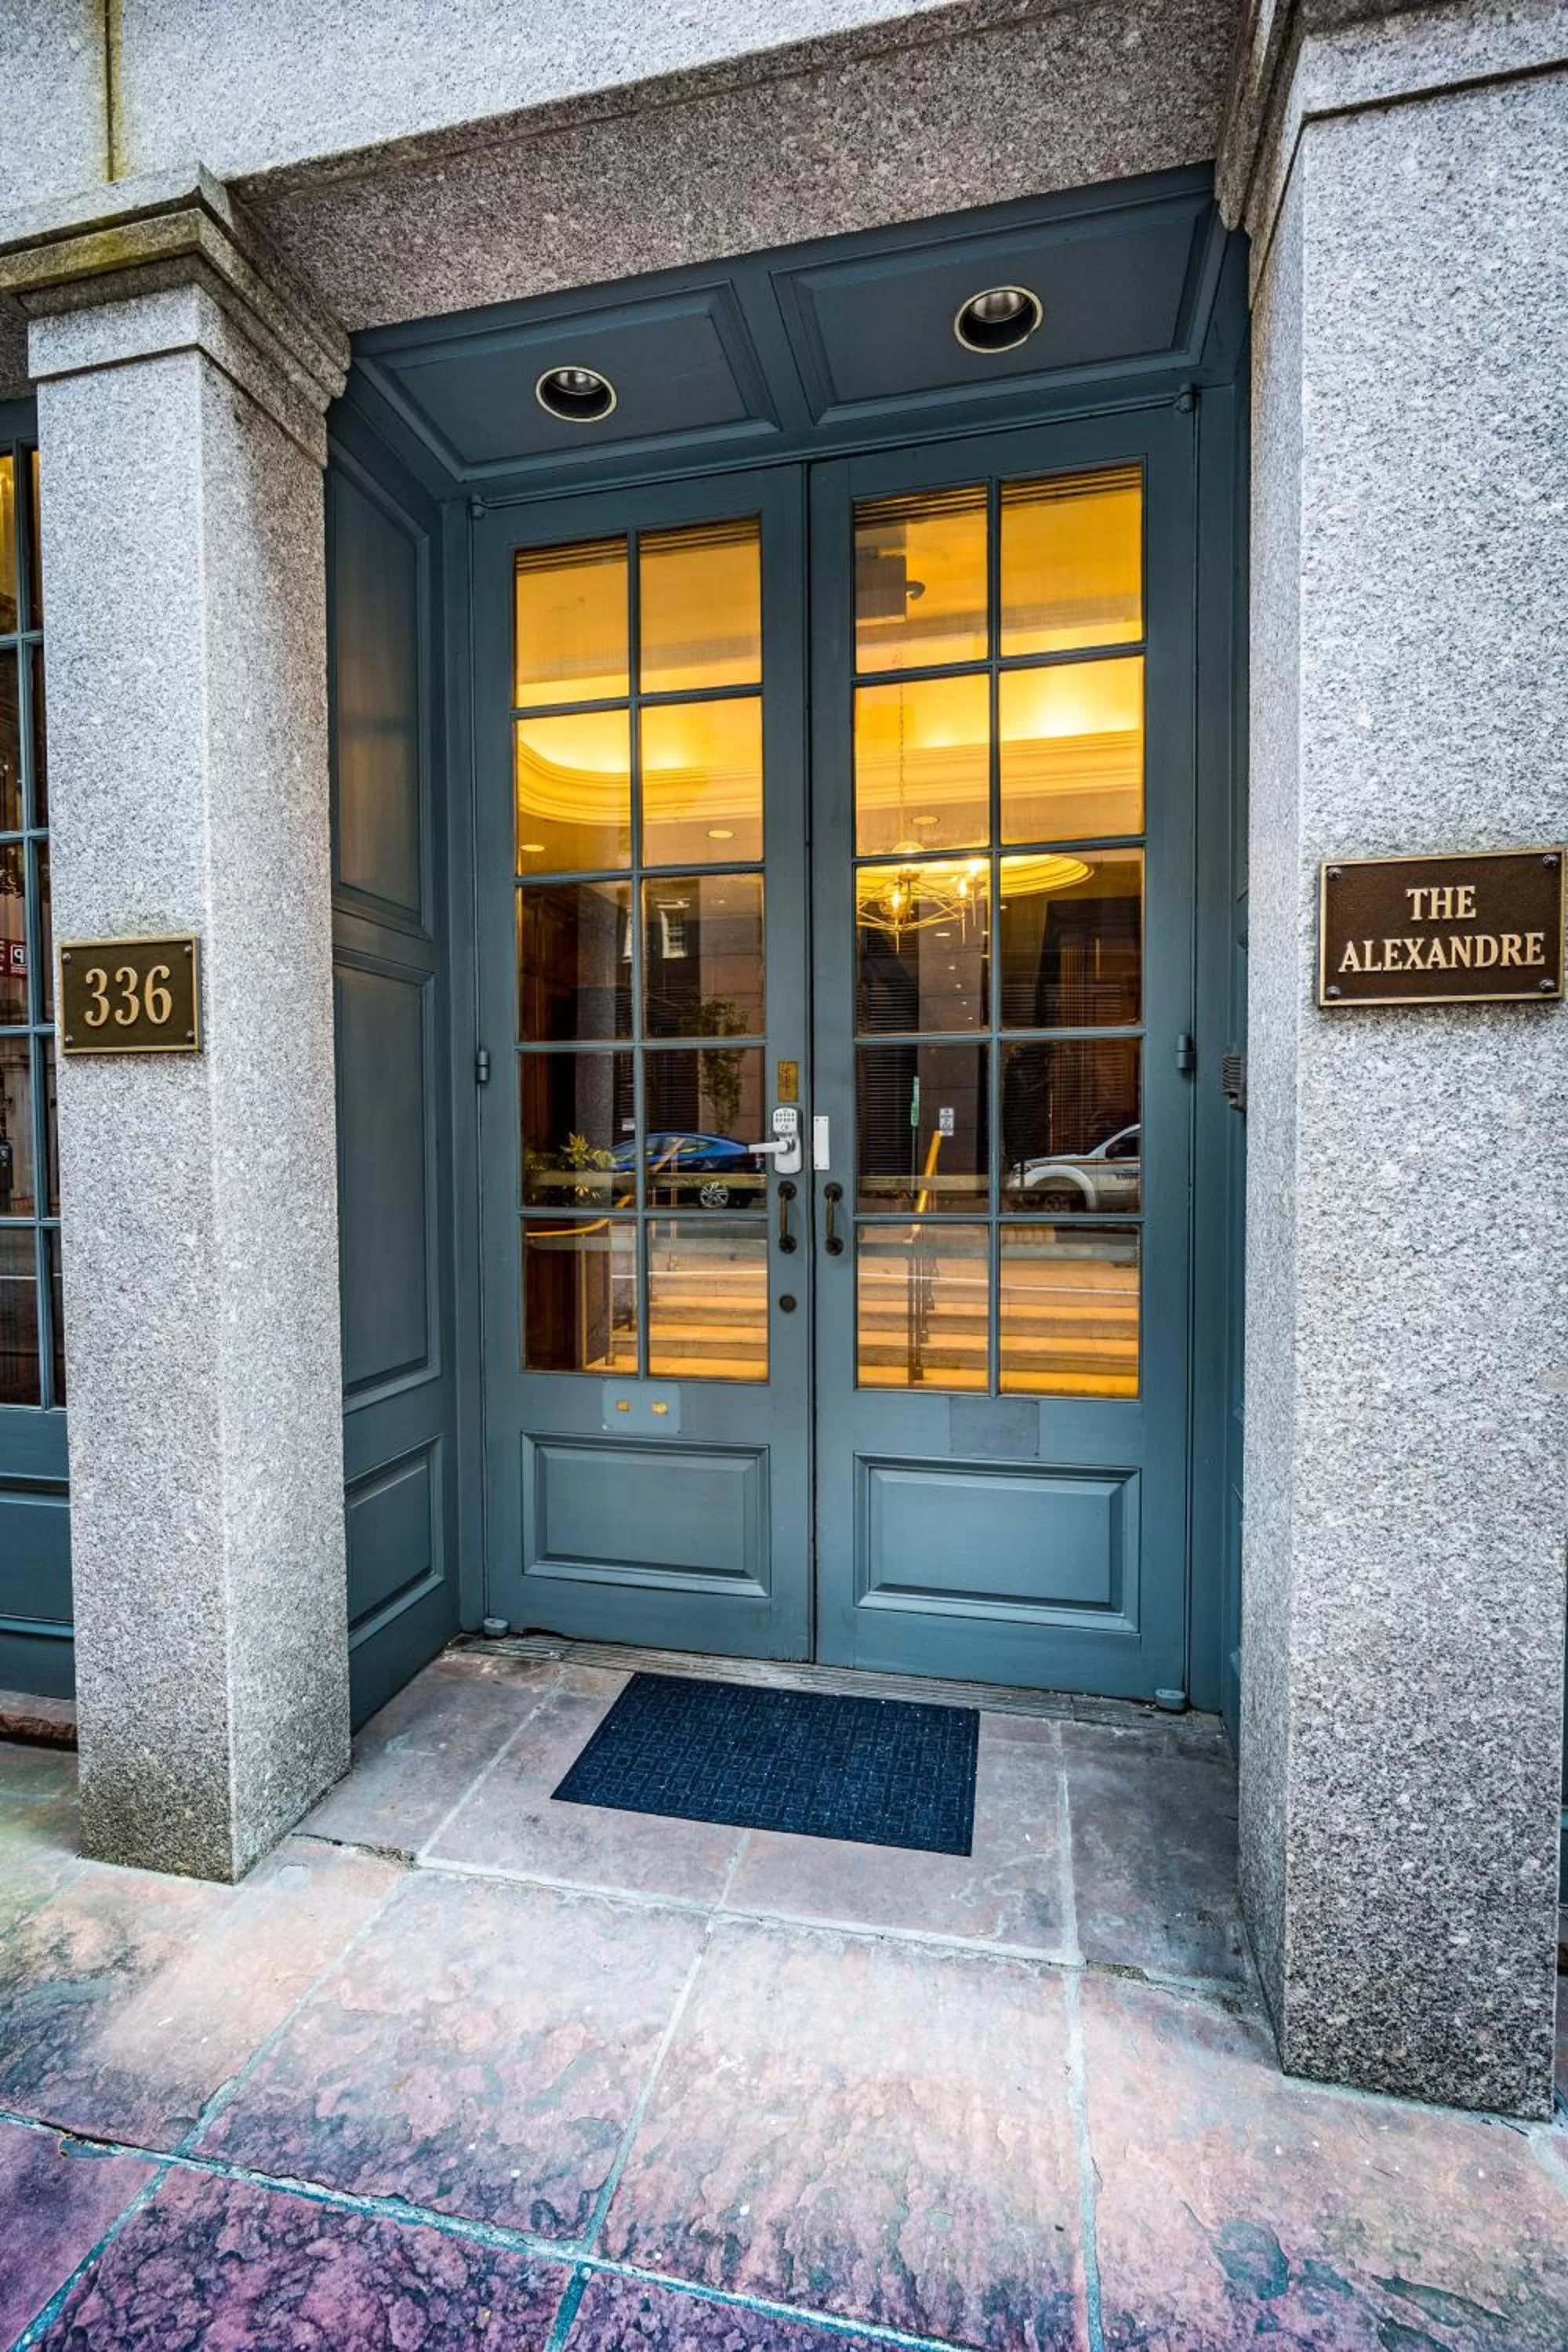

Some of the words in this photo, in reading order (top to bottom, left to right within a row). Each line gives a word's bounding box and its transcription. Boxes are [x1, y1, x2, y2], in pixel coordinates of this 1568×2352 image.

[1406, 885, 1476, 921] THE
[1338, 932, 1545, 973] ALEXANDRE
[84, 965, 173, 1027] 336
